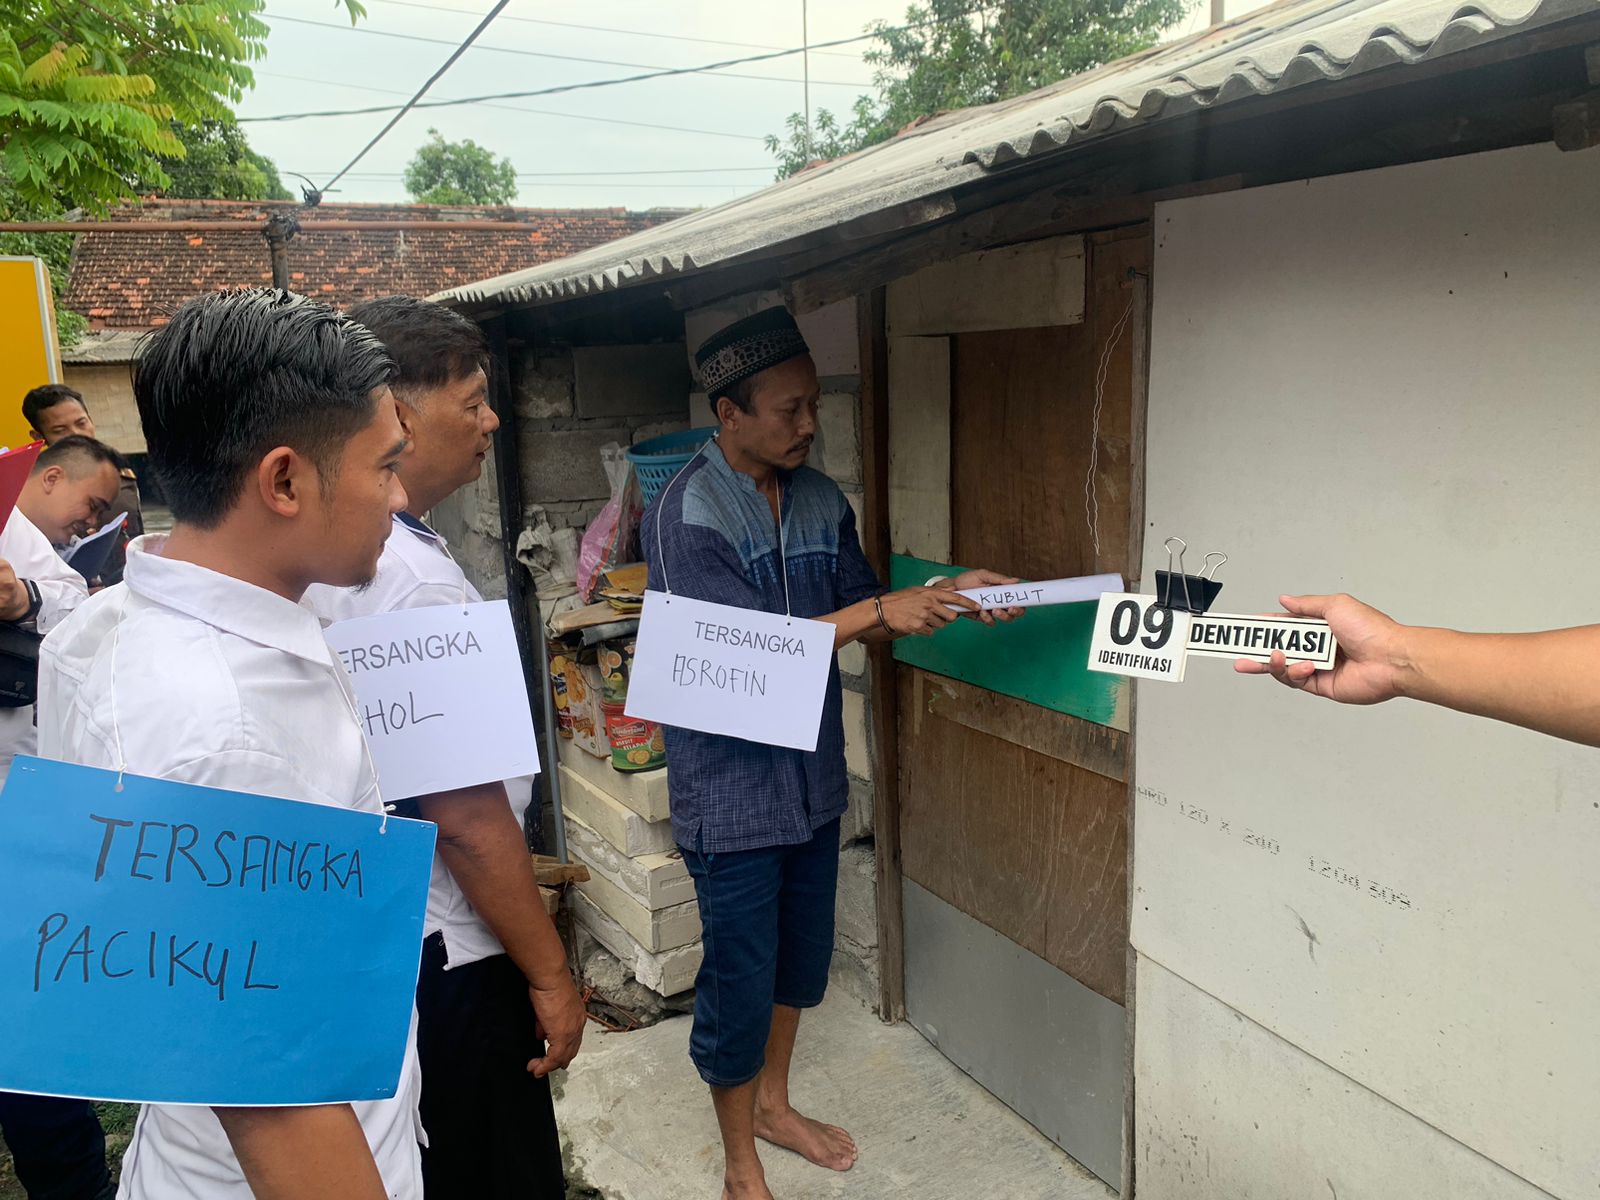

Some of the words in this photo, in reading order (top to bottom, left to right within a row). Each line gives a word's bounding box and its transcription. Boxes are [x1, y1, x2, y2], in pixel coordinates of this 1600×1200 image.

[980, 589, 1044, 605] KUBUT
[694, 620, 806, 657] TERSANGKA
[1110, 600, 1174, 650] 09
[1098, 650, 1172, 673] IDENTIFIKASI
[1178, 801, 1209, 825] 120
[90, 813, 363, 898] TERSANGKA
